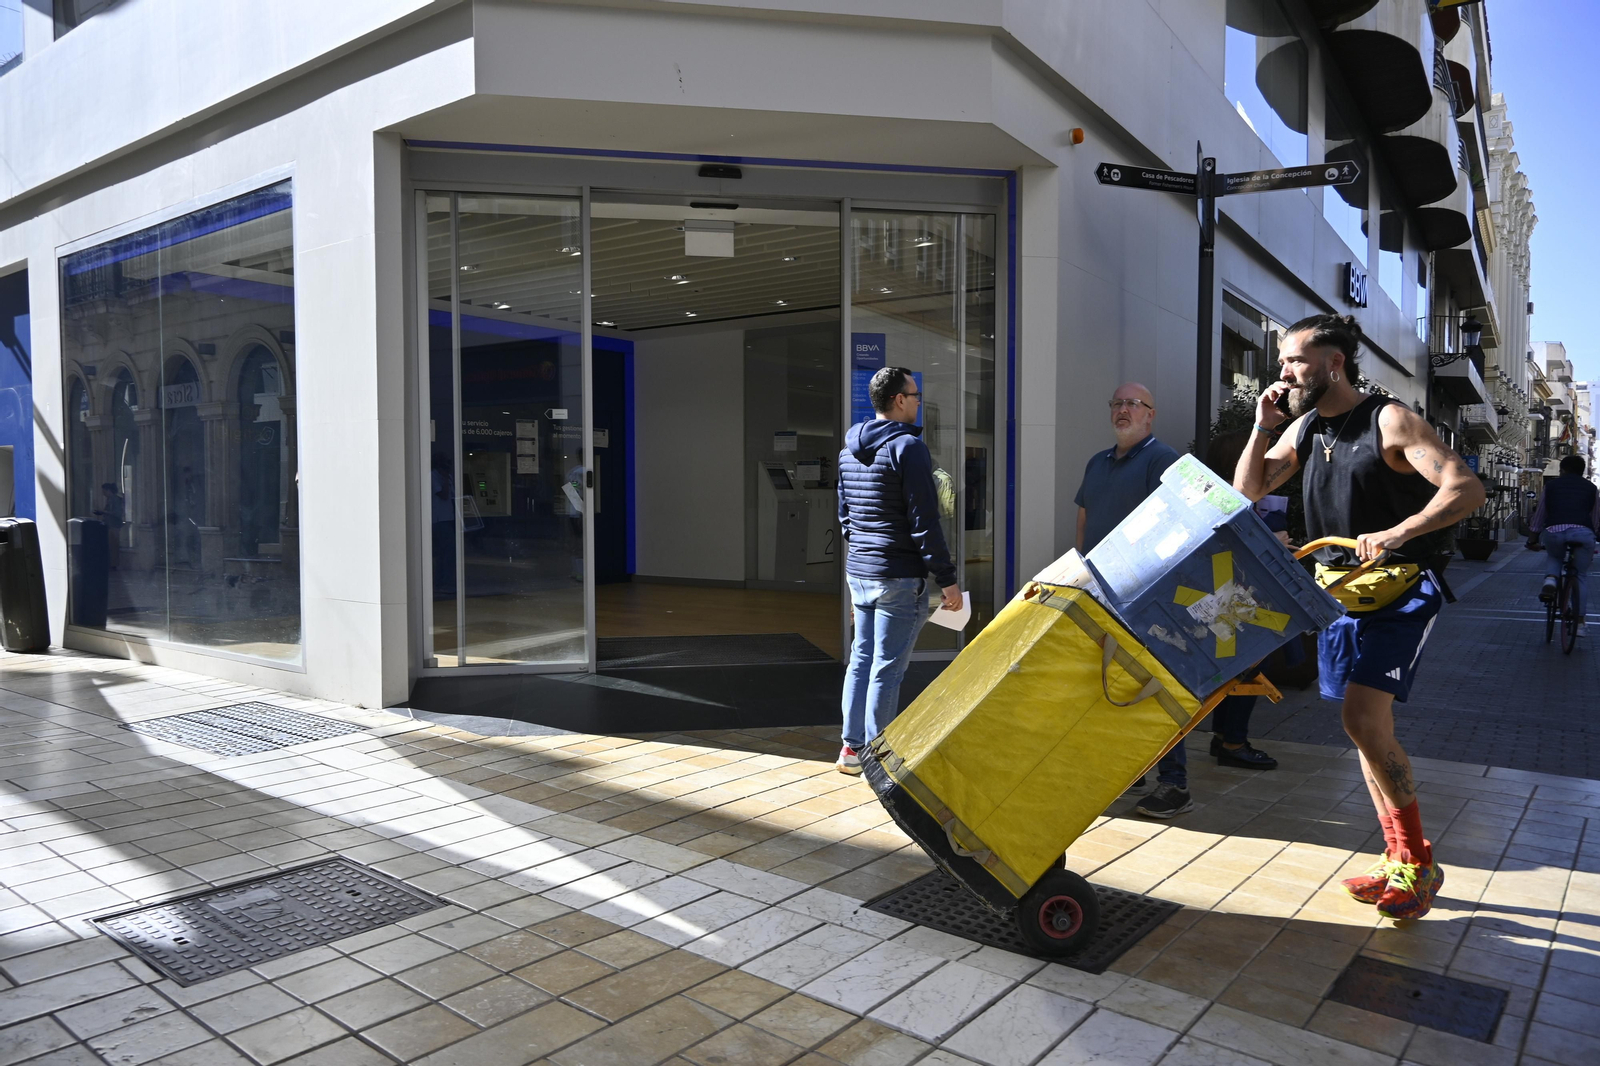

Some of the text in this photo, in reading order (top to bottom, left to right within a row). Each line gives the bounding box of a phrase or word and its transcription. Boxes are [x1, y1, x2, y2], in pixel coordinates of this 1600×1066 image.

[1141, 171, 1155, 180] Casa
[1164, 174, 1194, 184] Pescadores
[1227, 176, 1250, 185] Iglesia
[1251, 174, 1261, 182] de
[1271, 169, 1312, 180] Concepción
[1350, 268, 1368, 308] BBVA
[856, 344, 880, 352] BBVA
[475, 428, 493, 436] 6.000
[493, 429, 513, 437] cajeros
[552, 423, 561, 431] Tus
